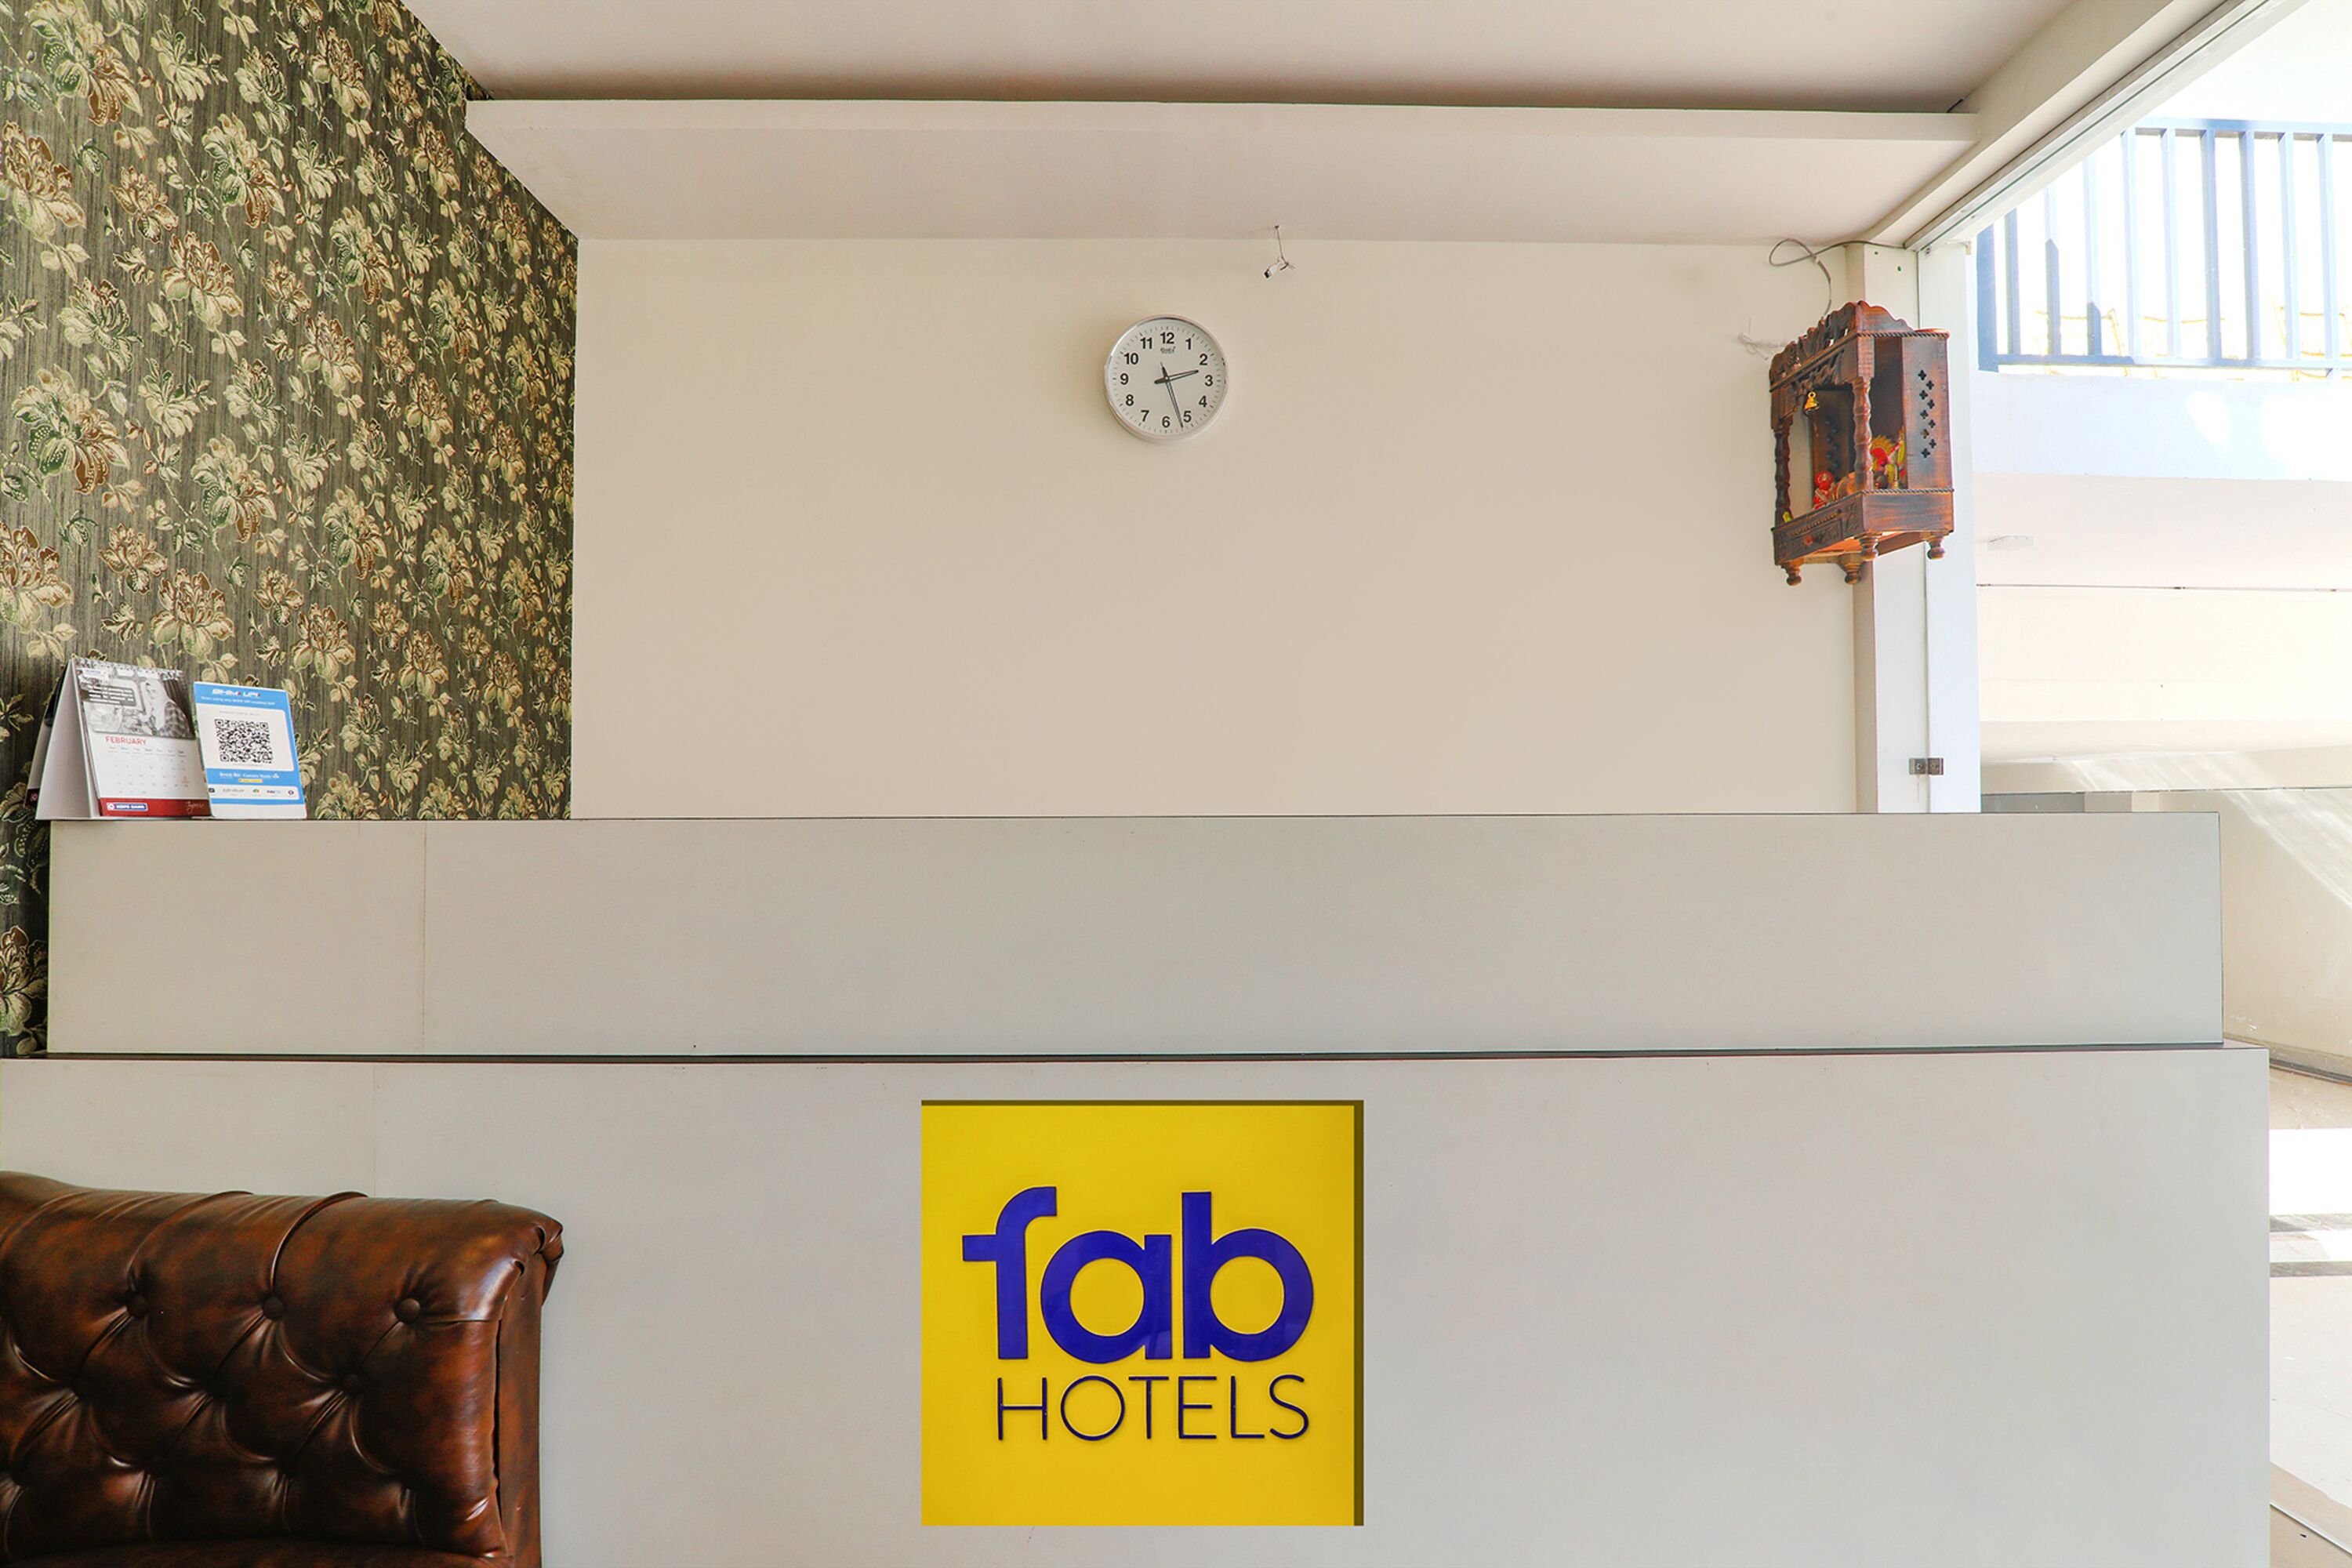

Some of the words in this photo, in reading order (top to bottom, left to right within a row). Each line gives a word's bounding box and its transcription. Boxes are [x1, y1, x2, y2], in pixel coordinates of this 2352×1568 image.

[1140, 337, 1152, 350] 11
[1160, 332, 1174, 344] 12
[1185, 337, 1192, 350] 1
[1123, 352, 1139, 365] 10
[1199, 353, 1208, 366] 2
[1120, 372, 1129, 386] 9
[1204, 374, 1214, 387] 3
[1125, 394, 1134, 407] 8
[1198, 395, 1207, 408] 4
[1141, 409, 1149, 422] 7
[1162, 416, 1171, 428] 6
[1183, 410, 1192, 423] 5
[105, 736, 147, 746] FEBRUARY
[962, 1186, 1314, 1364] fab
[998, 1375, 1308, 1441] HOTELS
